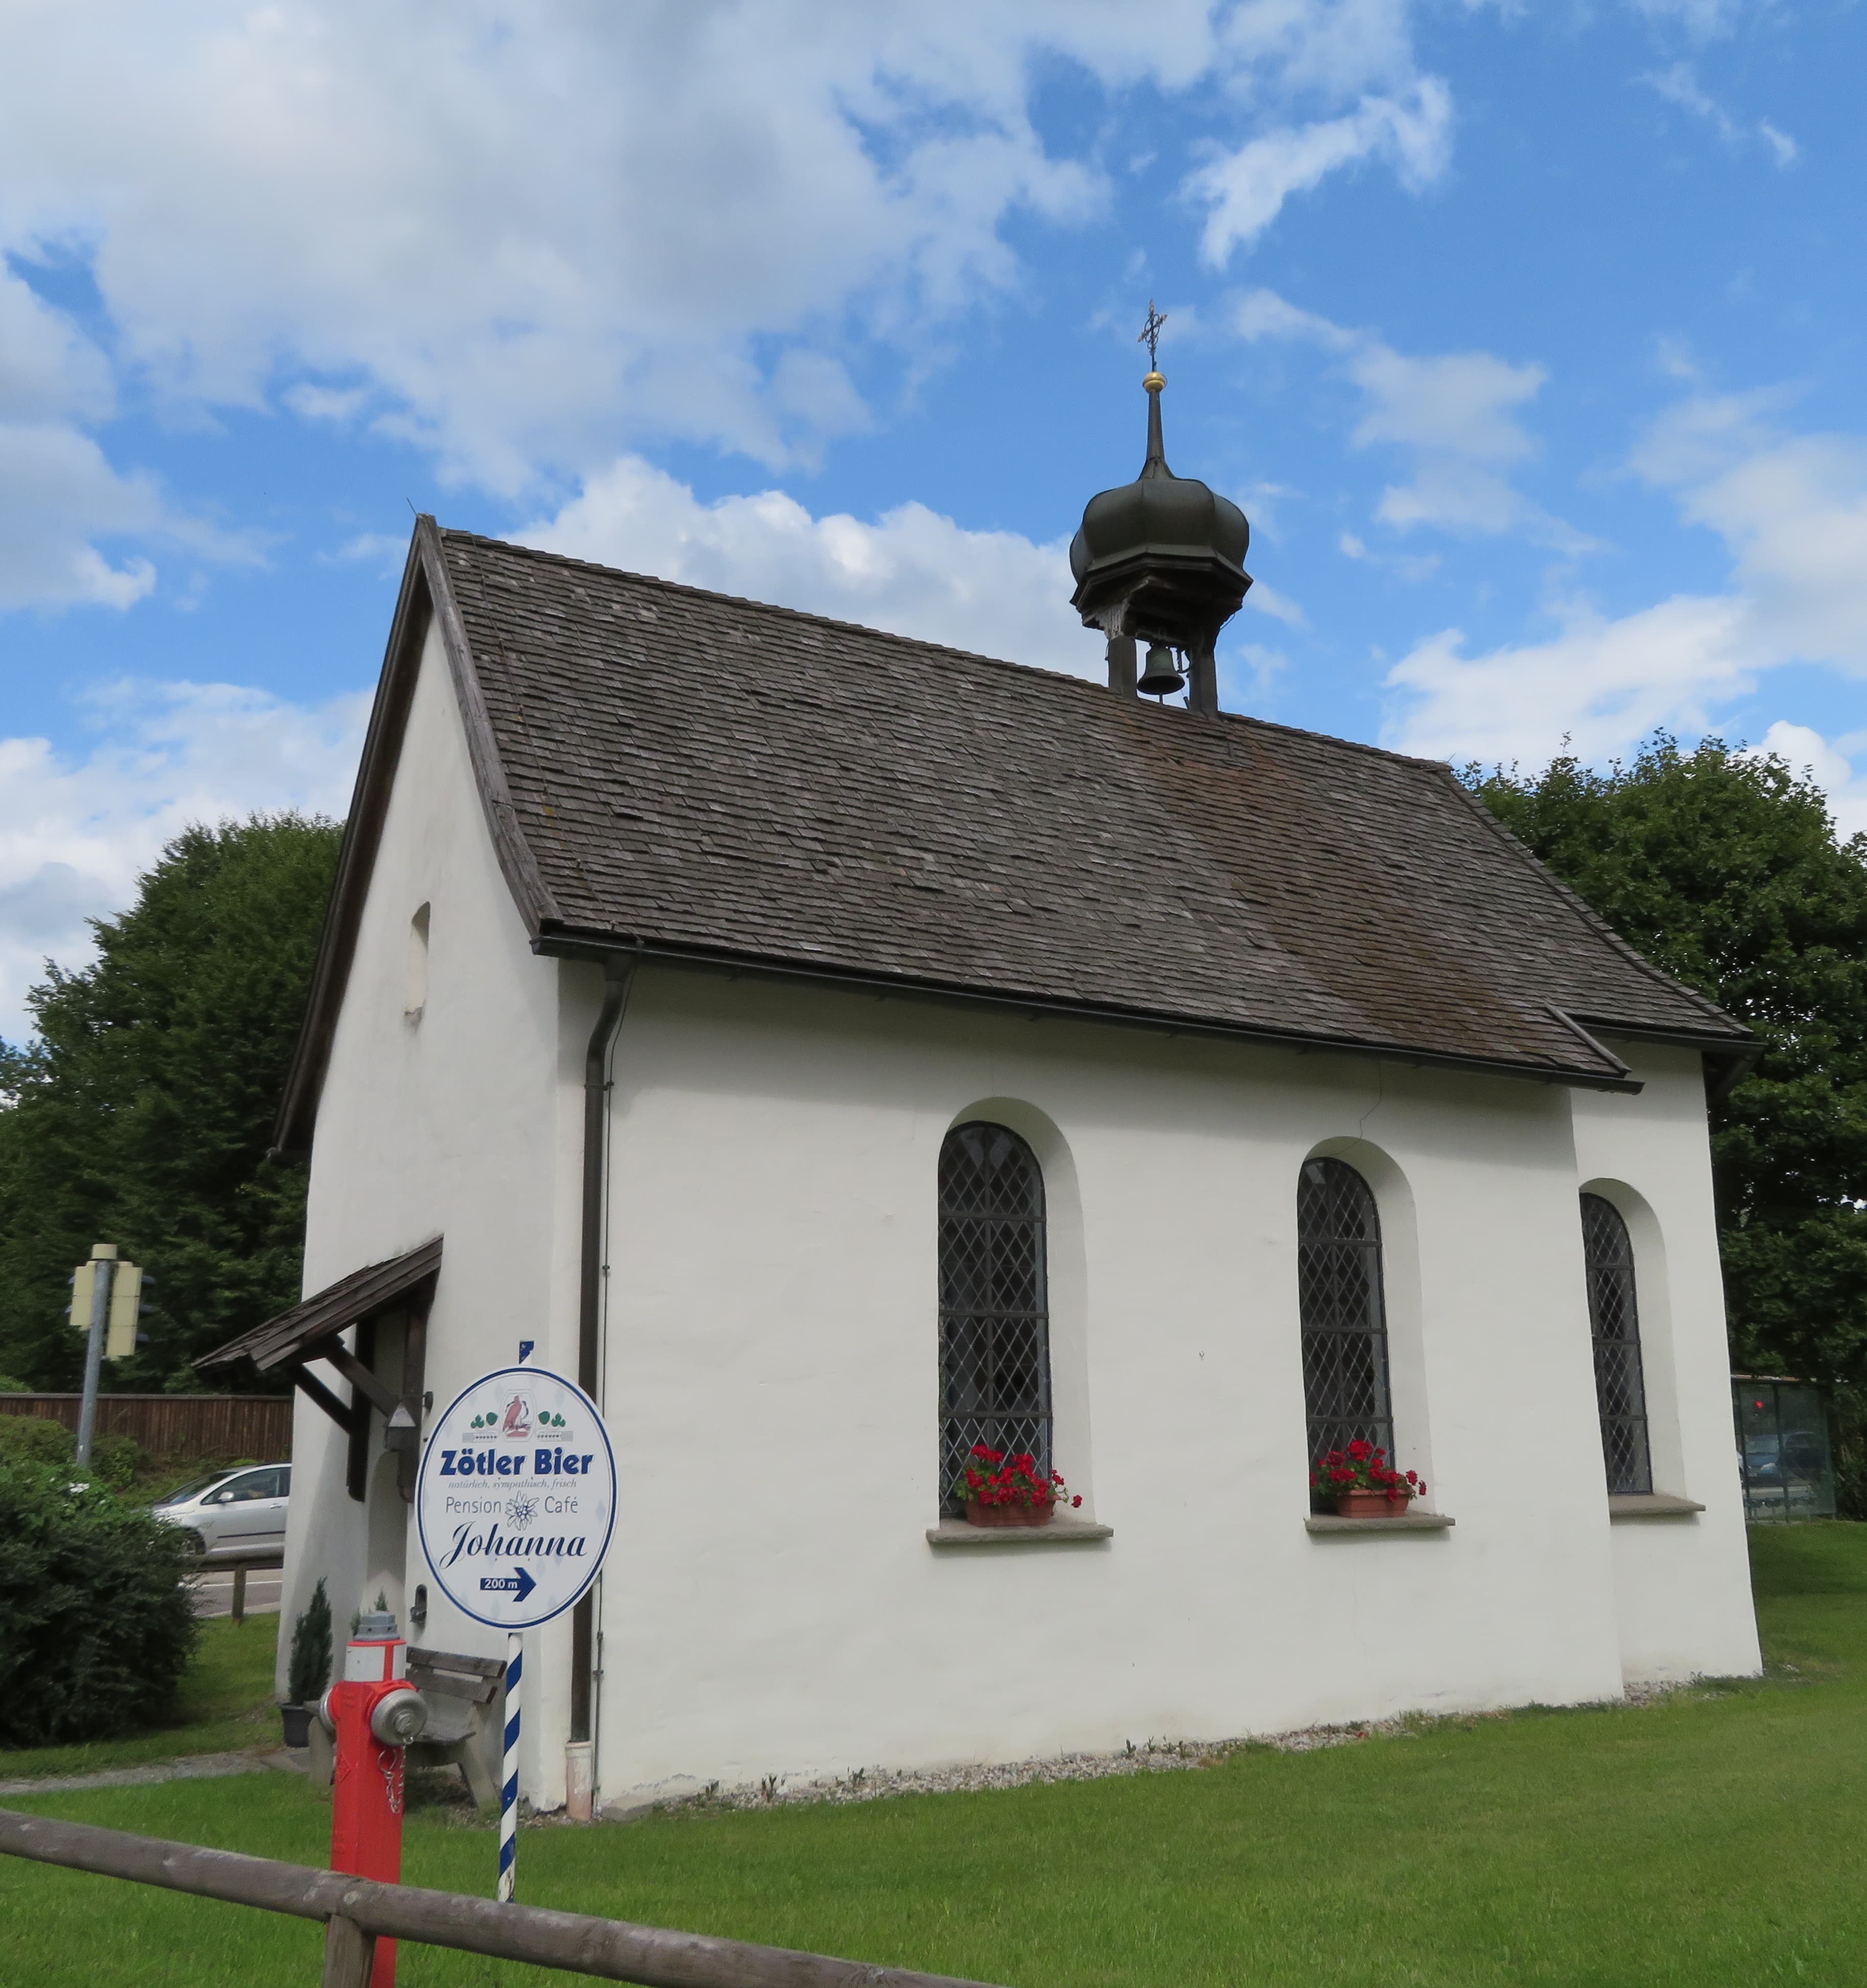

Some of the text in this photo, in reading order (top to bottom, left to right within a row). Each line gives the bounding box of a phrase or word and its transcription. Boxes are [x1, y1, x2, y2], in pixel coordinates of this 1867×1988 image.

[439, 1447, 594, 1475] Zötler Bier
[448, 1478, 577, 1492] natürlich, sympathisch, frisch
[446, 1496, 578, 1513] Pension Café
[439, 1521, 587, 1569] Johanna
[484, 1579, 518, 1589] 200 m
